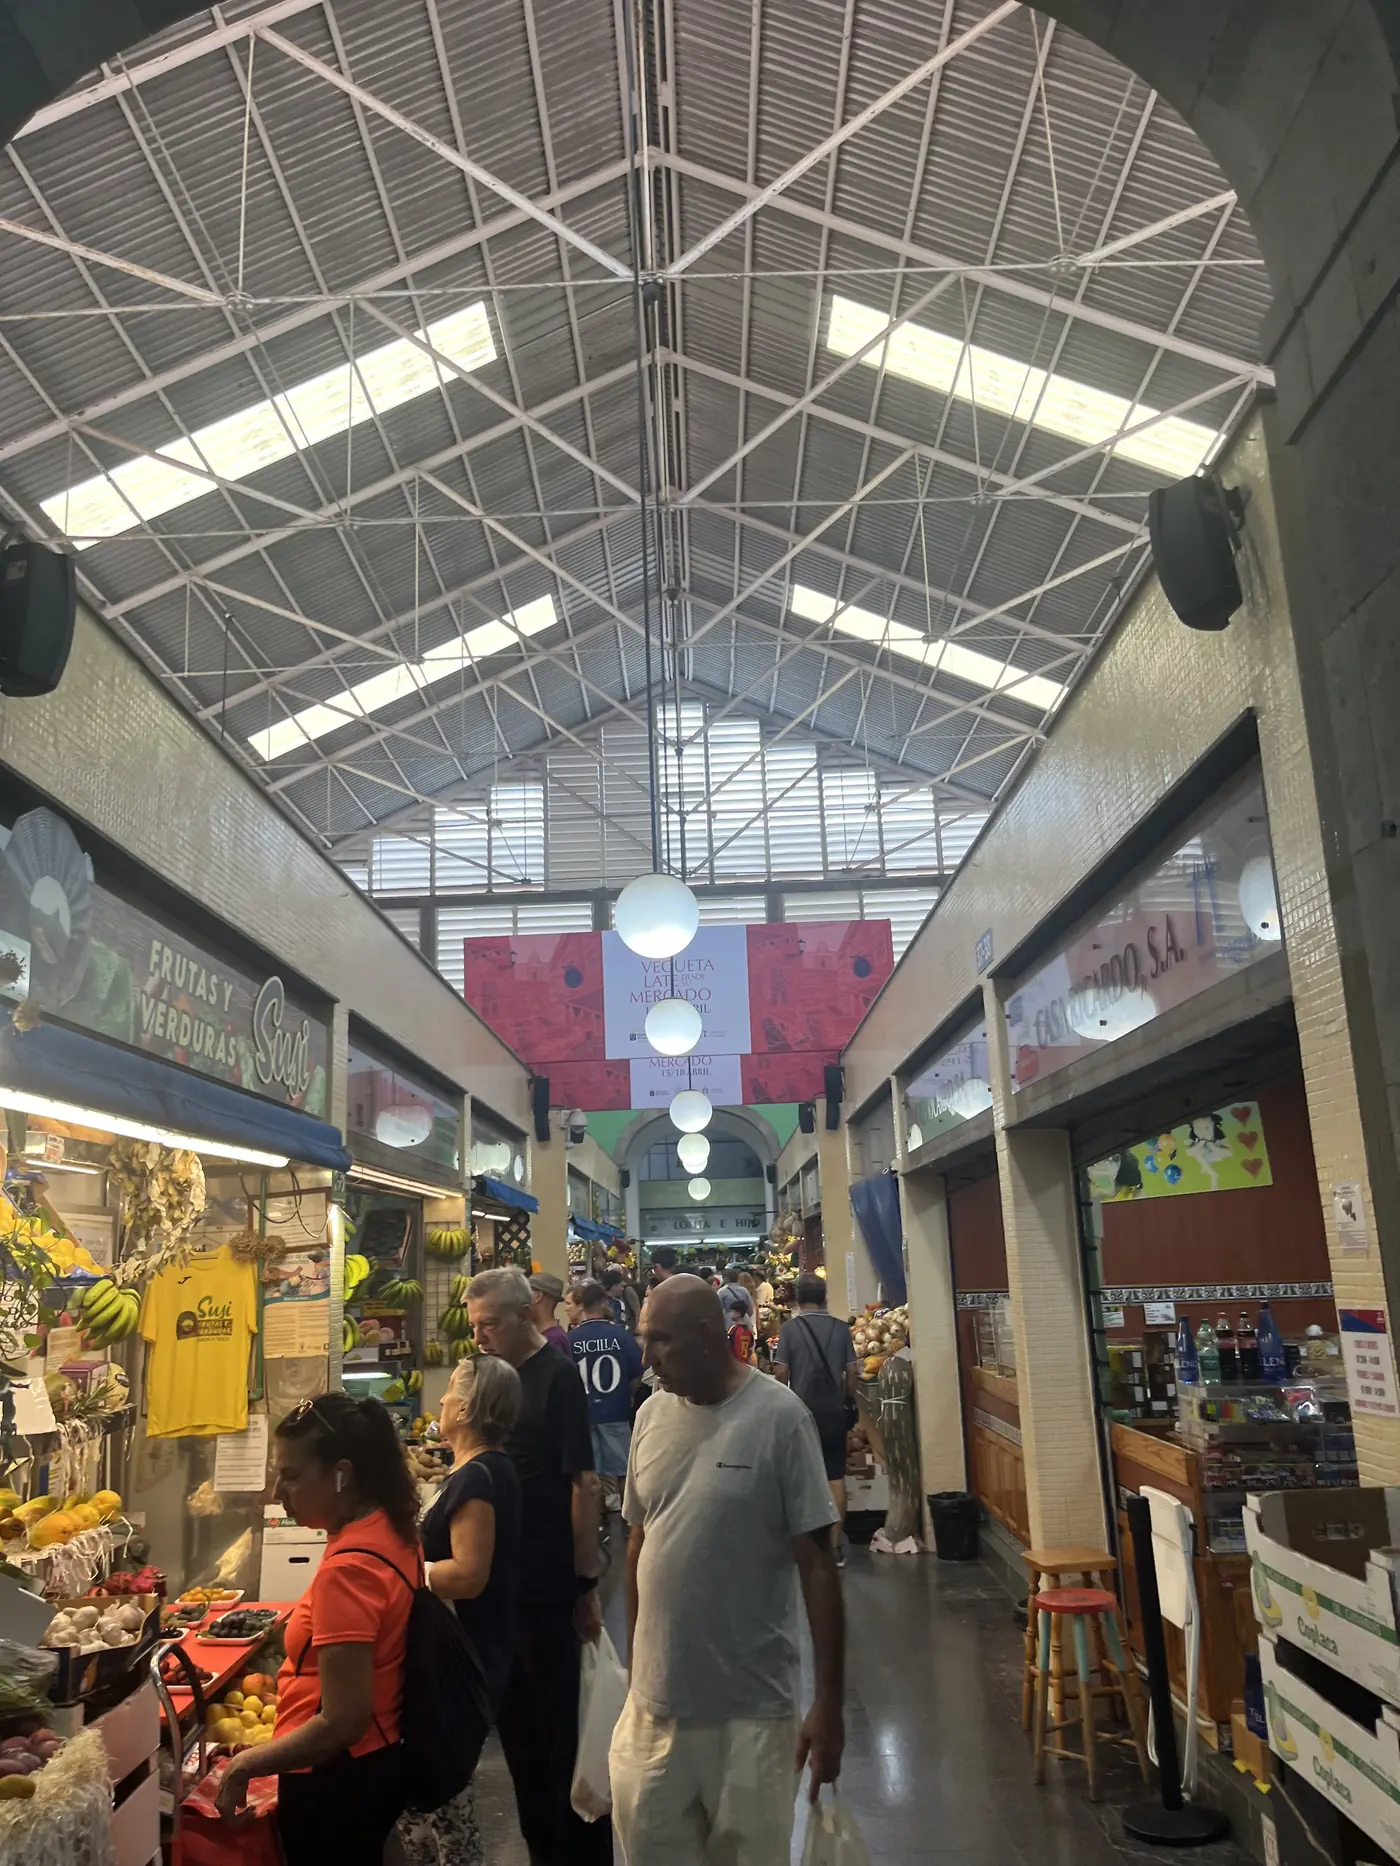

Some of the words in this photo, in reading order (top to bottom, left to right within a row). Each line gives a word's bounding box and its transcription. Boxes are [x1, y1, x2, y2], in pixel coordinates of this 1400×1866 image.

[1147, 913, 1185, 980] S.A.
[149, 939, 219, 1005] FRUTAS
[223, 981, 234, 1012] Y
[644, 974, 678, 988] LATE
[629, 988, 712, 1003] MERCADO
[141, 993, 237, 1066] VERDURAS
[649, 1056, 712, 1068] MERCADO
[661, 1069, 685, 1077] 15/18
[686, 1068, 711, 1076] ABRIL
[577, 1354, 622, 1394] 10
